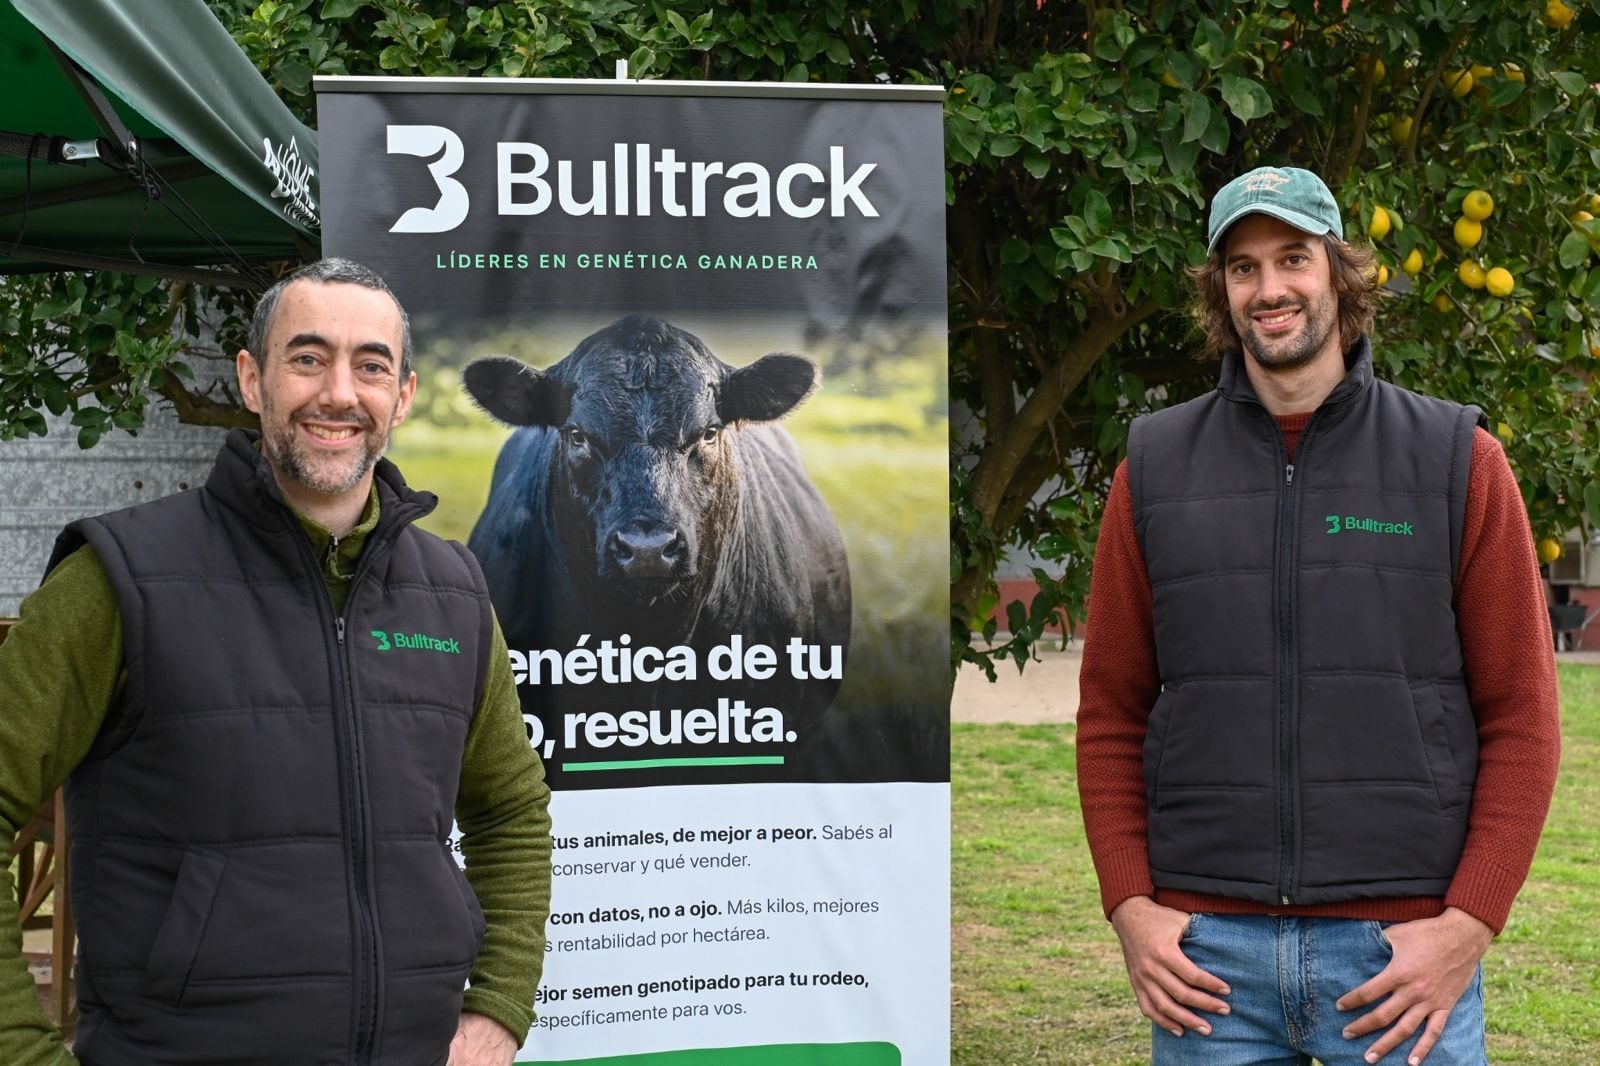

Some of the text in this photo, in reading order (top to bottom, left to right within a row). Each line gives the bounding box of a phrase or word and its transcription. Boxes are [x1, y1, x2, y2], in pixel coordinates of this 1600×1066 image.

[497, 142, 880, 218] Bulltrack
[437, 251, 817, 269] LÍDERES EN GENÉTICA GANADERA
[1345, 516, 1412, 536] Bulltrack
[393, 632, 459, 653] Bulltrack
[508, 633, 842, 685] enética de tu
[565, 698, 797, 748] resuelta.
[584, 830, 668, 848] animales,
[673, 828, 695, 842] de
[701, 826, 752, 844] mejor
[757, 829, 766, 839] a
[772, 829, 816, 842] peor.
[823, 825, 873, 840] Sabés
[879, 824, 892, 838] al
[552, 853, 750, 876] conservar y qué vender.
[550, 898, 878, 925] con datos, no a ojo. Más kilos, mejores
[558, 931, 655, 952] rentabilidad
[662, 932, 688, 948] por
[694, 927, 769, 942] hectárea.
[535, 971, 868, 1004] ejor semen genotipado para tu rodeo,
[673, 1005, 708, 1021] para
[714, 1003, 746, 1015] vos.
